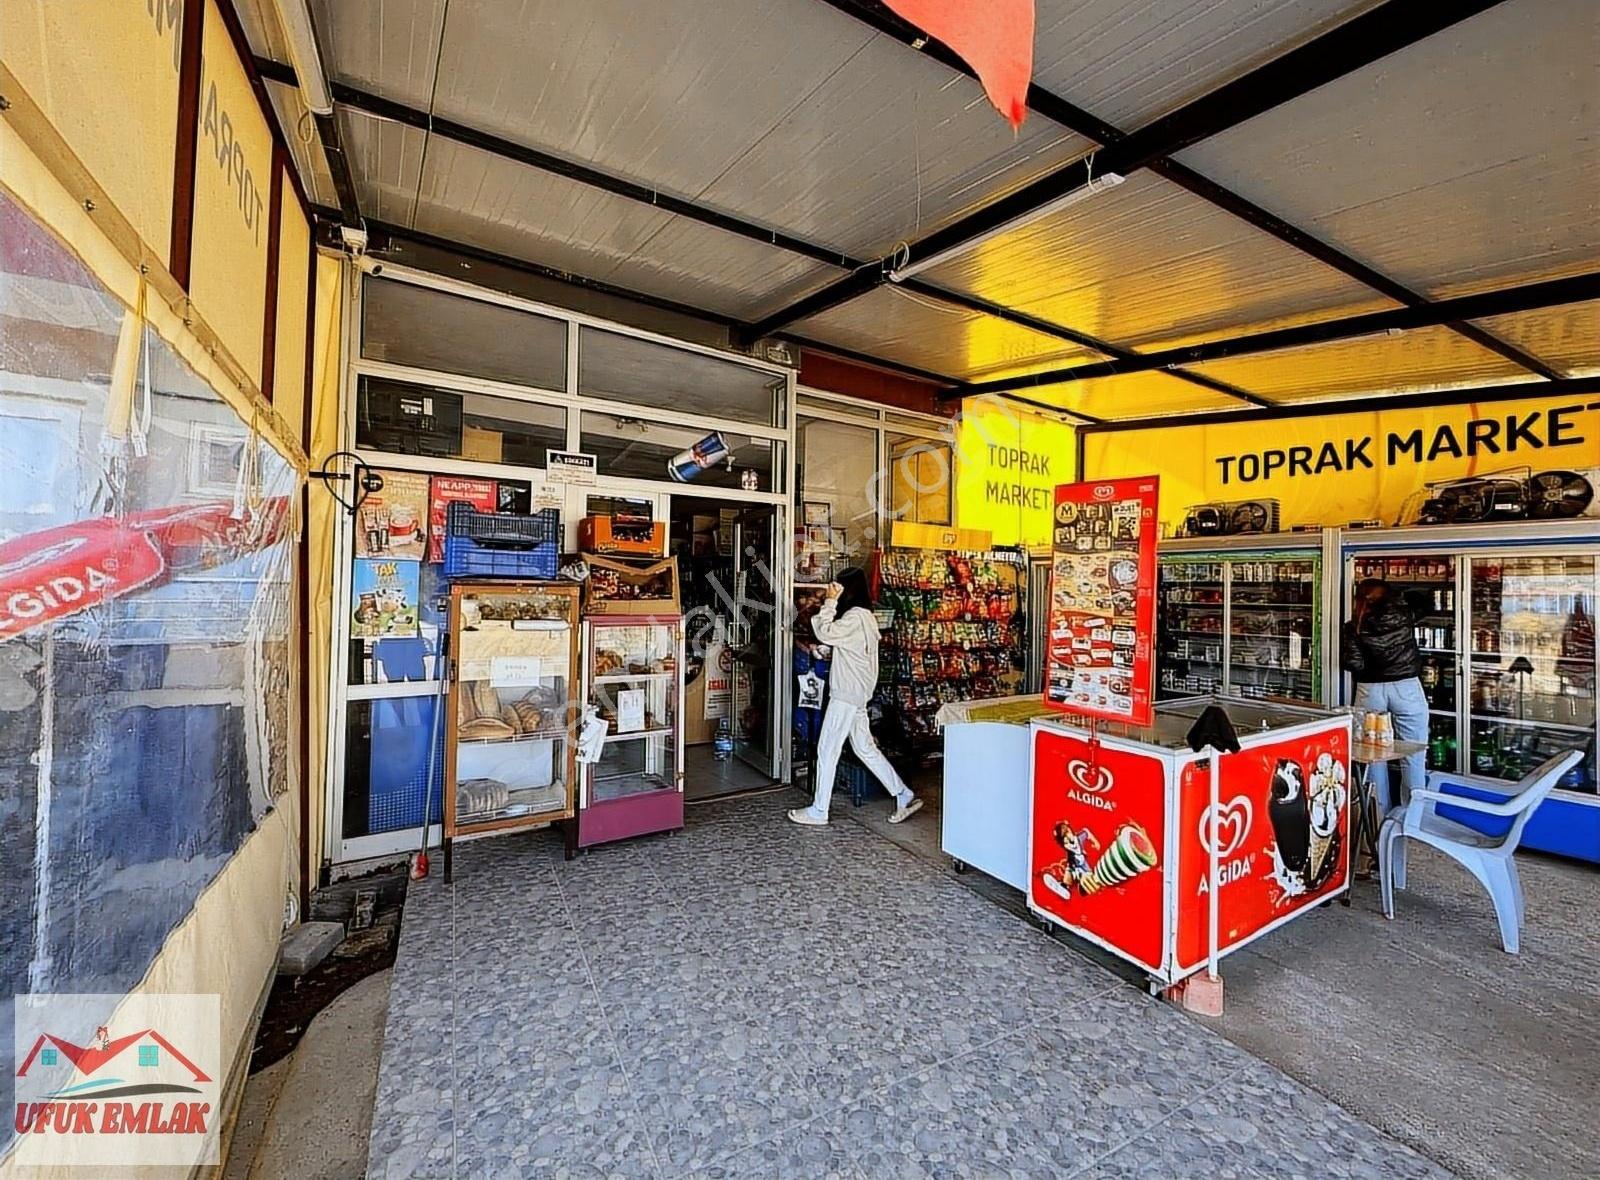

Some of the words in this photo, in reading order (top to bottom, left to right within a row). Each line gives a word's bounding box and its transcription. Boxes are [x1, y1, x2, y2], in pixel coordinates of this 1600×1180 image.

[987, 444, 1050, 476] TOPRAK
[1215, 436, 1374, 485] TOPRAK
[986, 481, 1051, 511] MARKET
[1197, 857, 1252, 897] AGiDA
